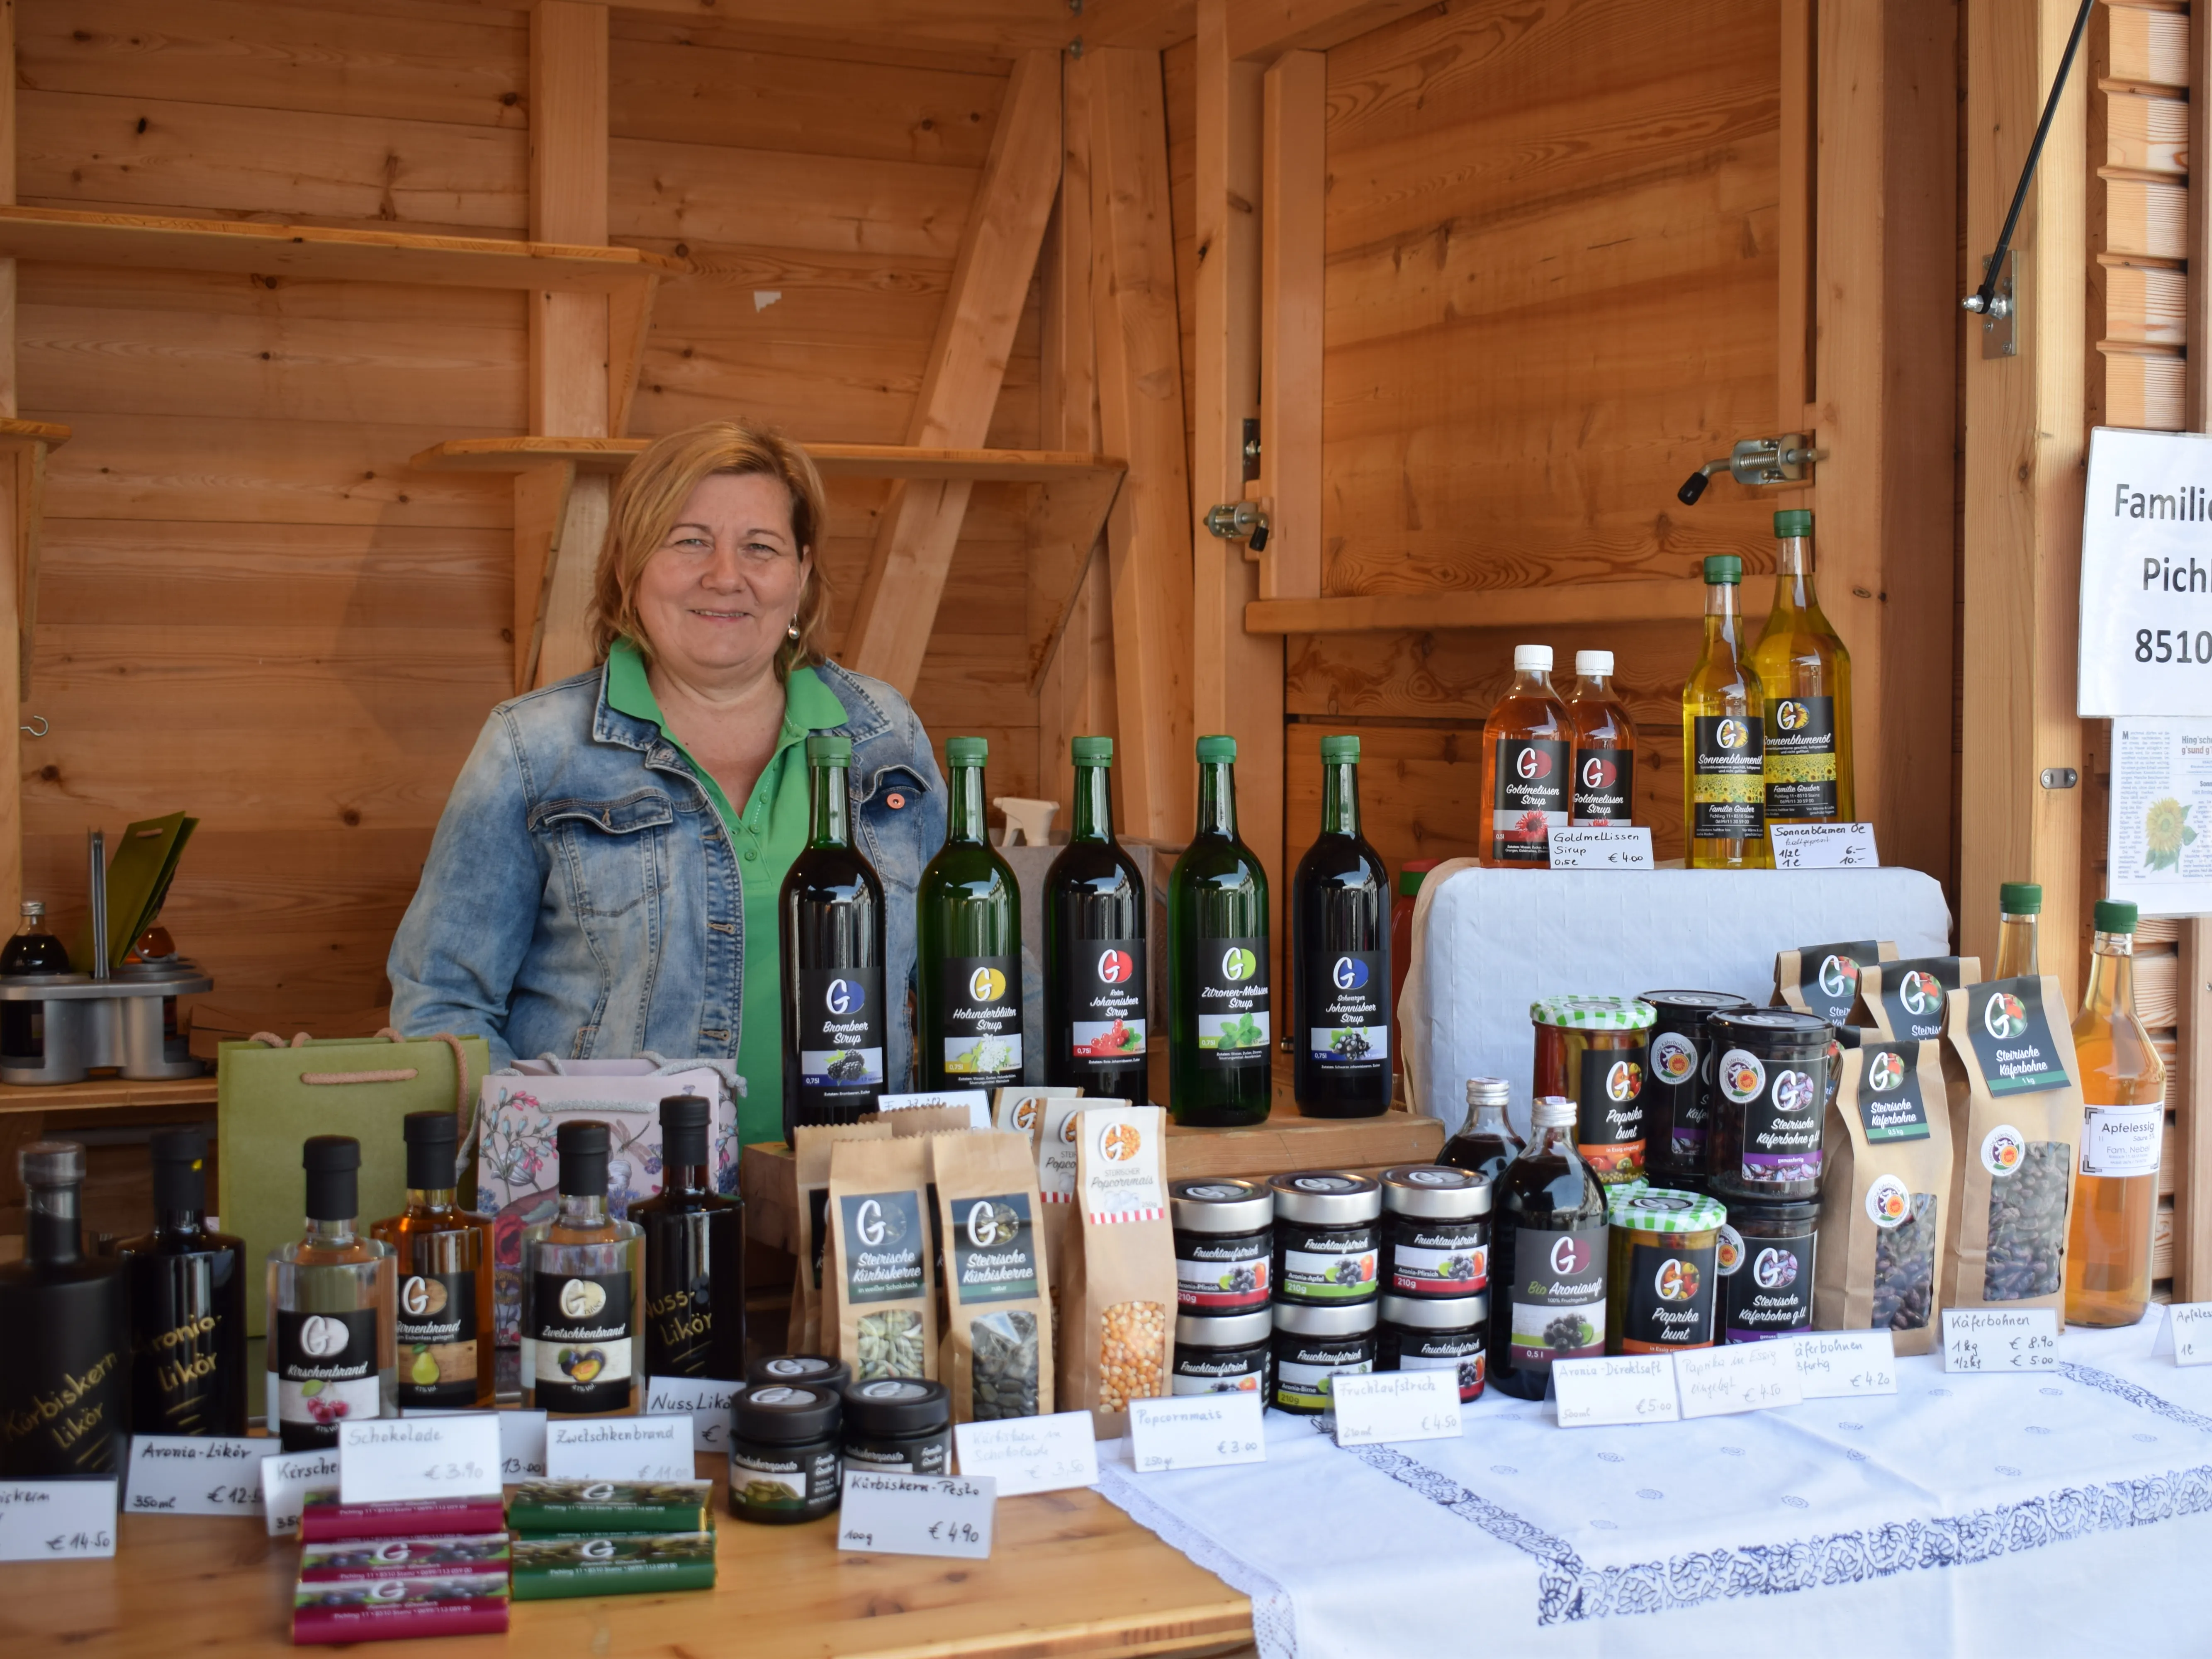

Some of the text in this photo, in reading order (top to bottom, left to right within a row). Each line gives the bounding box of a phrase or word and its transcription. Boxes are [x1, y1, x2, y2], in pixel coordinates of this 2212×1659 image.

[2134, 628, 2212, 664] 8510
[1764, 733, 1831, 745] Sonnenblumenöl
[1698, 754, 1762, 764] Sonnenblumenöl
[1506, 784, 1559, 795] Goldmelissen
[1521, 795, 1545, 807] Sirup
[1574, 793, 1623, 804] Goldmelissen
[1587, 804, 1611, 816] Sirup
[1554, 832, 1639, 842] Goldmellissen
[1774, 826, 1846, 836] Sonnenblumen
[1554, 847, 1587, 856] Sirup
[1608, 852, 1643, 863] € 4.00
[1202, 985, 1268, 998] Zitronen-Melissen
[1090, 995, 1139, 1007] Johannisbeer
[1229, 997, 1253, 1010] Sirup
[1326, 1003, 1376, 1013] Johannisbeer
[953, 1007, 1017, 1019] Holunderblüten
[1105, 1007, 1128, 1018] Sirup
[1340, 1013, 1364, 1024] Sirup
[823, 1020, 869, 1033] Brombeer
[976, 1019, 1003, 1031] Sirup
[833, 1033, 861, 1046] Sirup
[1996, 1044, 2040, 1062] Steirische
[1999, 1059, 2048, 1079] Käferbohne
[1871, 1098, 1912, 1113] Steirische
[1606, 1106, 1643, 1124] Paprika
[1771, 1116, 1814, 1129] Steirische
[1871, 1112, 1917, 1129] Käferbohne
[1615, 1125, 1637, 1139] bunt
[2101, 1121, 2154, 1134] Apfelessig
[1756, 1132, 1808, 1148] Käferbohne
[2129, 1145, 2150, 1153] Nebel
[1105, 1168, 1141, 1177] STEIRISCHER
[1091, 1175, 1153, 1190] Popcornmais
[1304, 1237, 1369, 1254] Fruchtaufstrich
[1414, 1233, 1477, 1249] Fruchtaufstrich
[857, 1251, 915, 1267] Steirische
[967, 1249, 1026, 1267] Steirische
[1193, 1244, 1259, 1260] Fruchtaufstrich
[853, 1265, 921, 1283] Kürbiskerne
[963, 1267, 1034, 1283] Kürbiskerne
[1287, 1271, 1325, 1282] Aronia-Apfel
[1398, 1266, 1438, 1277] Aronia-Pfirsich
[1287, 1283, 1307, 1294] 210g
[1397, 1277, 1416, 1288] 210g
[1528, 1276, 1602, 1297] Bio Aroniasaft
[1178, 1293, 1197, 1304] 210g
[1753, 1293, 1798, 1306] Steirische
[1652, 1308, 1699, 1323] Paprika
[1739, 1308, 1791, 1325] Käferbohne
[542, 1323, 626, 1339] Zwetschkenbrand
[1952, 1314, 2029, 1335] Käferbohnen
[1661, 1325, 1690, 1340] bunt
[1421, 1338, 1480, 1356] Fruchtaufstrich
[1794, 1339, 1863, 1357] äferbohnen
[1963, 1341, 1978, 1357] kg
[1297, 1348, 1362, 1365] Fruchtaufstrich
[1683, 1350, 1776, 1376] Paprika in Essig
[288, 1360, 368, 1379] Kirschenbrand
[1181, 1360, 1248, 1377] Fruchtaufstrich
[1339, 1375, 1436, 1397] Fruchtaufstrich
[1866, 1372, 1890, 1386] 4.20
[1281, 1382, 1316, 1394] Aronia-Birne
[5, 1352, 117, 1443] Kürbiskern
[651, 1393, 694, 1410] Nuss
[1281, 1394, 1299, 1405] 210g
[1136, 1409, 1222, 1426] Popcornmais
[1562, 1407, 1590, 1419] 500ml
[1433, 1413, 1457, 1429] 4.50
[348, 1423, 443, 1445] Schokolade
[556, 1424, 675, 1444] Zwetschkenbrand
[1217, 1440, 1226, 1454] €
[133, 1485, 227, 1509] 350ml €
[928, 1520, 979, 1542] € 4.90
[69, 1531, 111, 1549] 14.50
